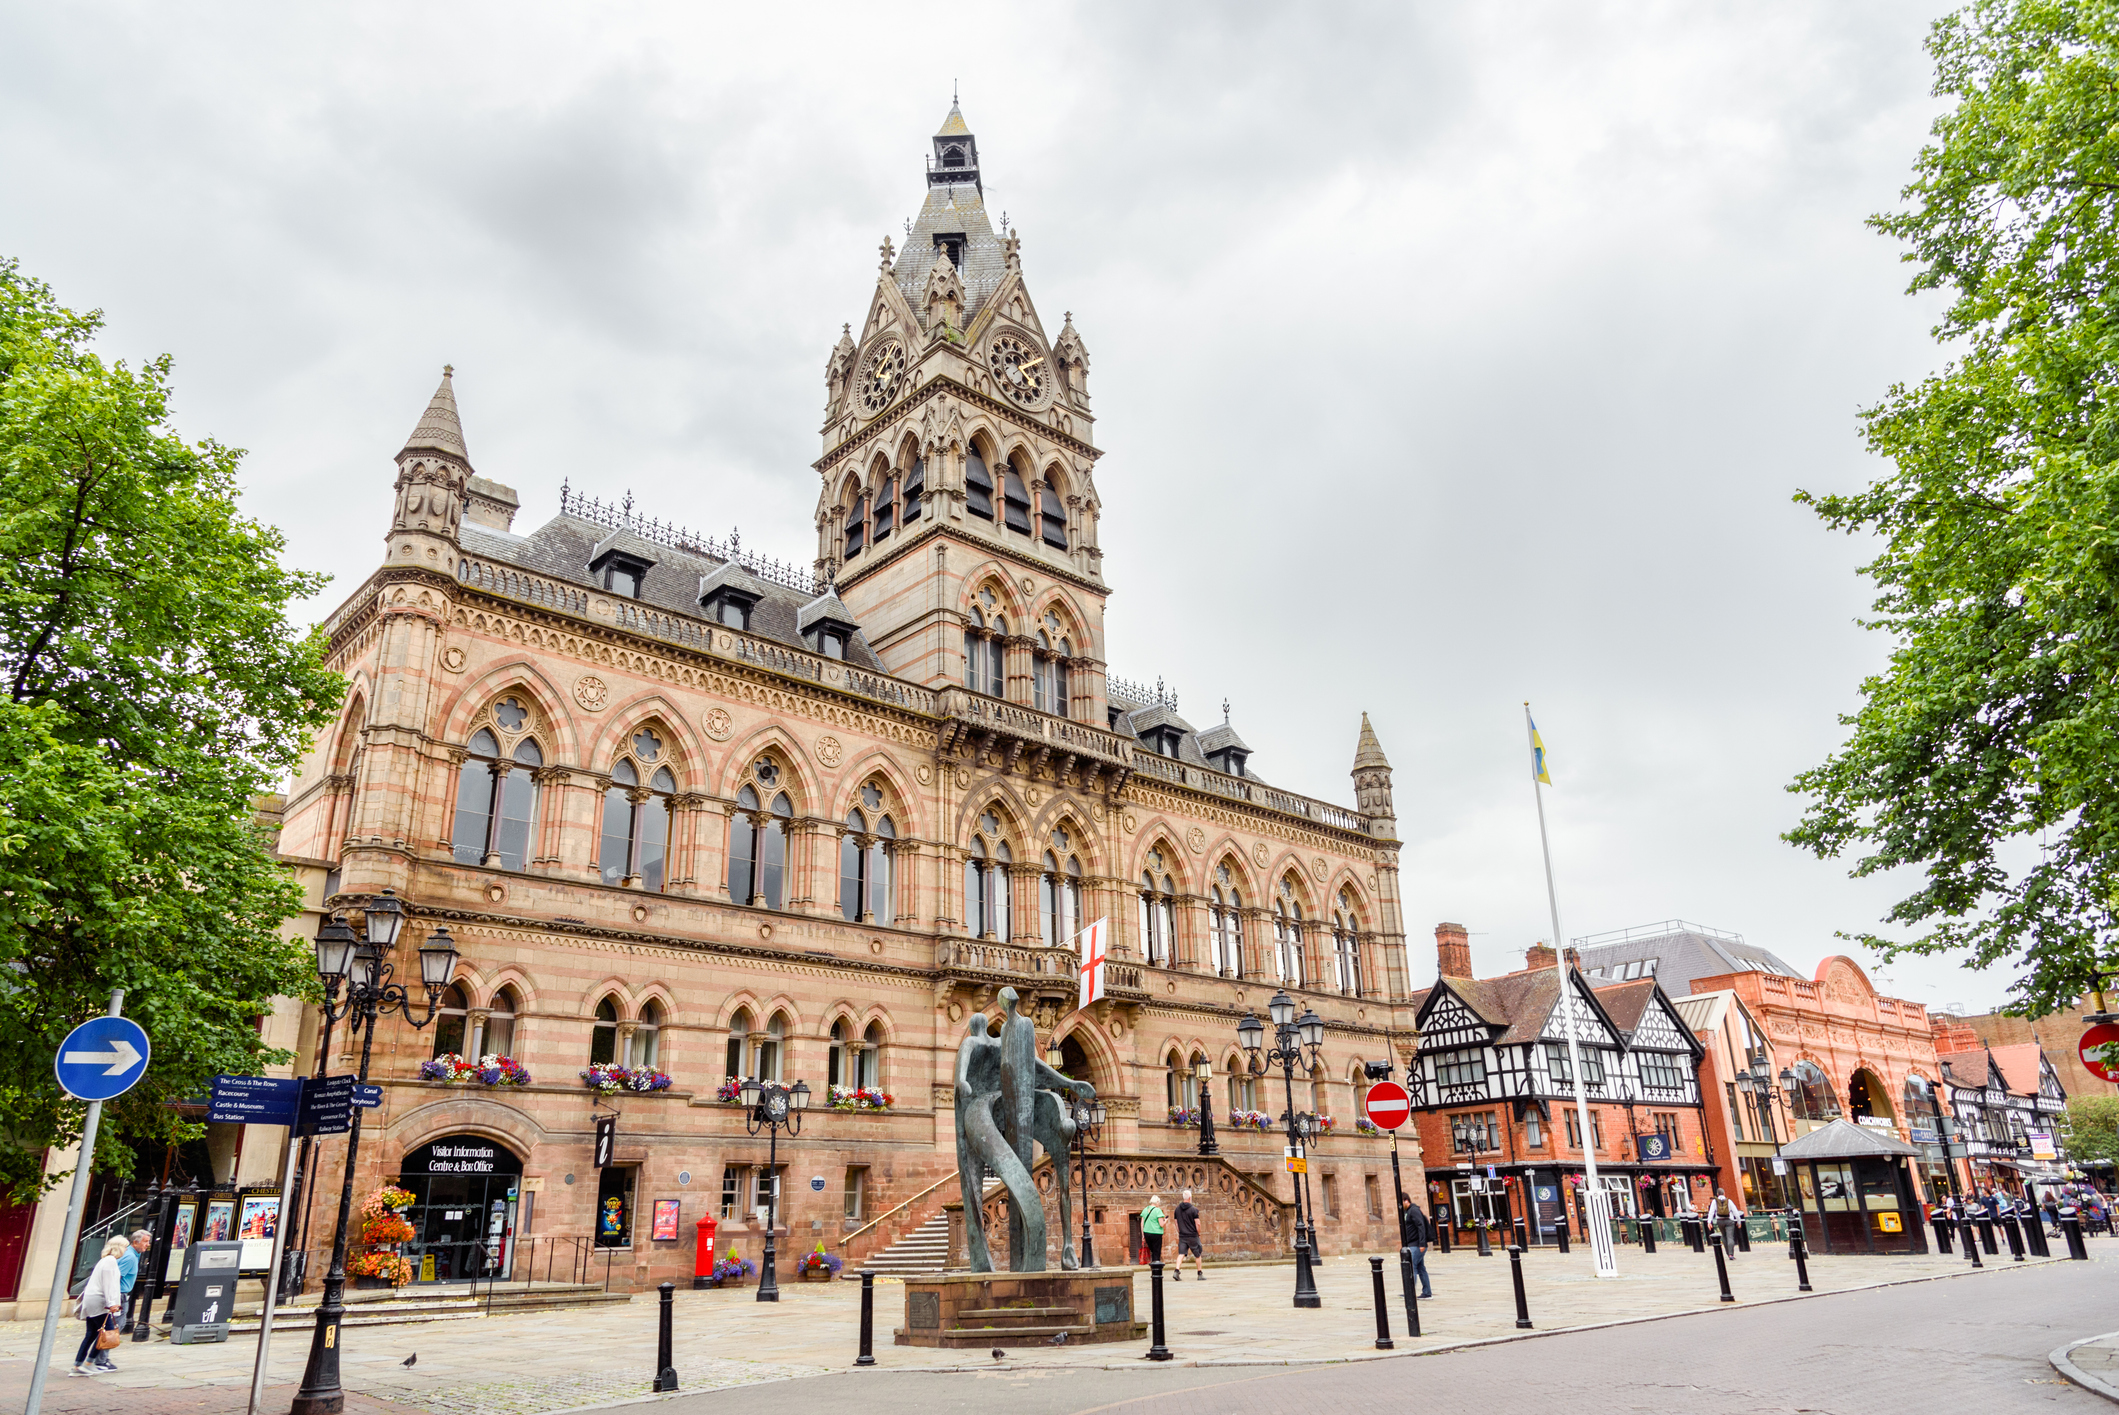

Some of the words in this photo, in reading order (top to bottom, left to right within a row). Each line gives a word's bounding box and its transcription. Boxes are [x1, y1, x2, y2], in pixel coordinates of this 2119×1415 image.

[218, 1088, 250, 1098] Racecourse
[215, 1101, 232, 1109] Castle
[1858, 1115, 1893, 1128] COACHWORKS
[432, 1145, 453, 1156] Visitor
[453, 1145, 494, 1158] Information
[428, 1160, 454, 1172] Centre
[453, 1162, 460, 1172] &
[460, 1160, 474, 1172] Box
[474, 1160, 494, 1172] Office
